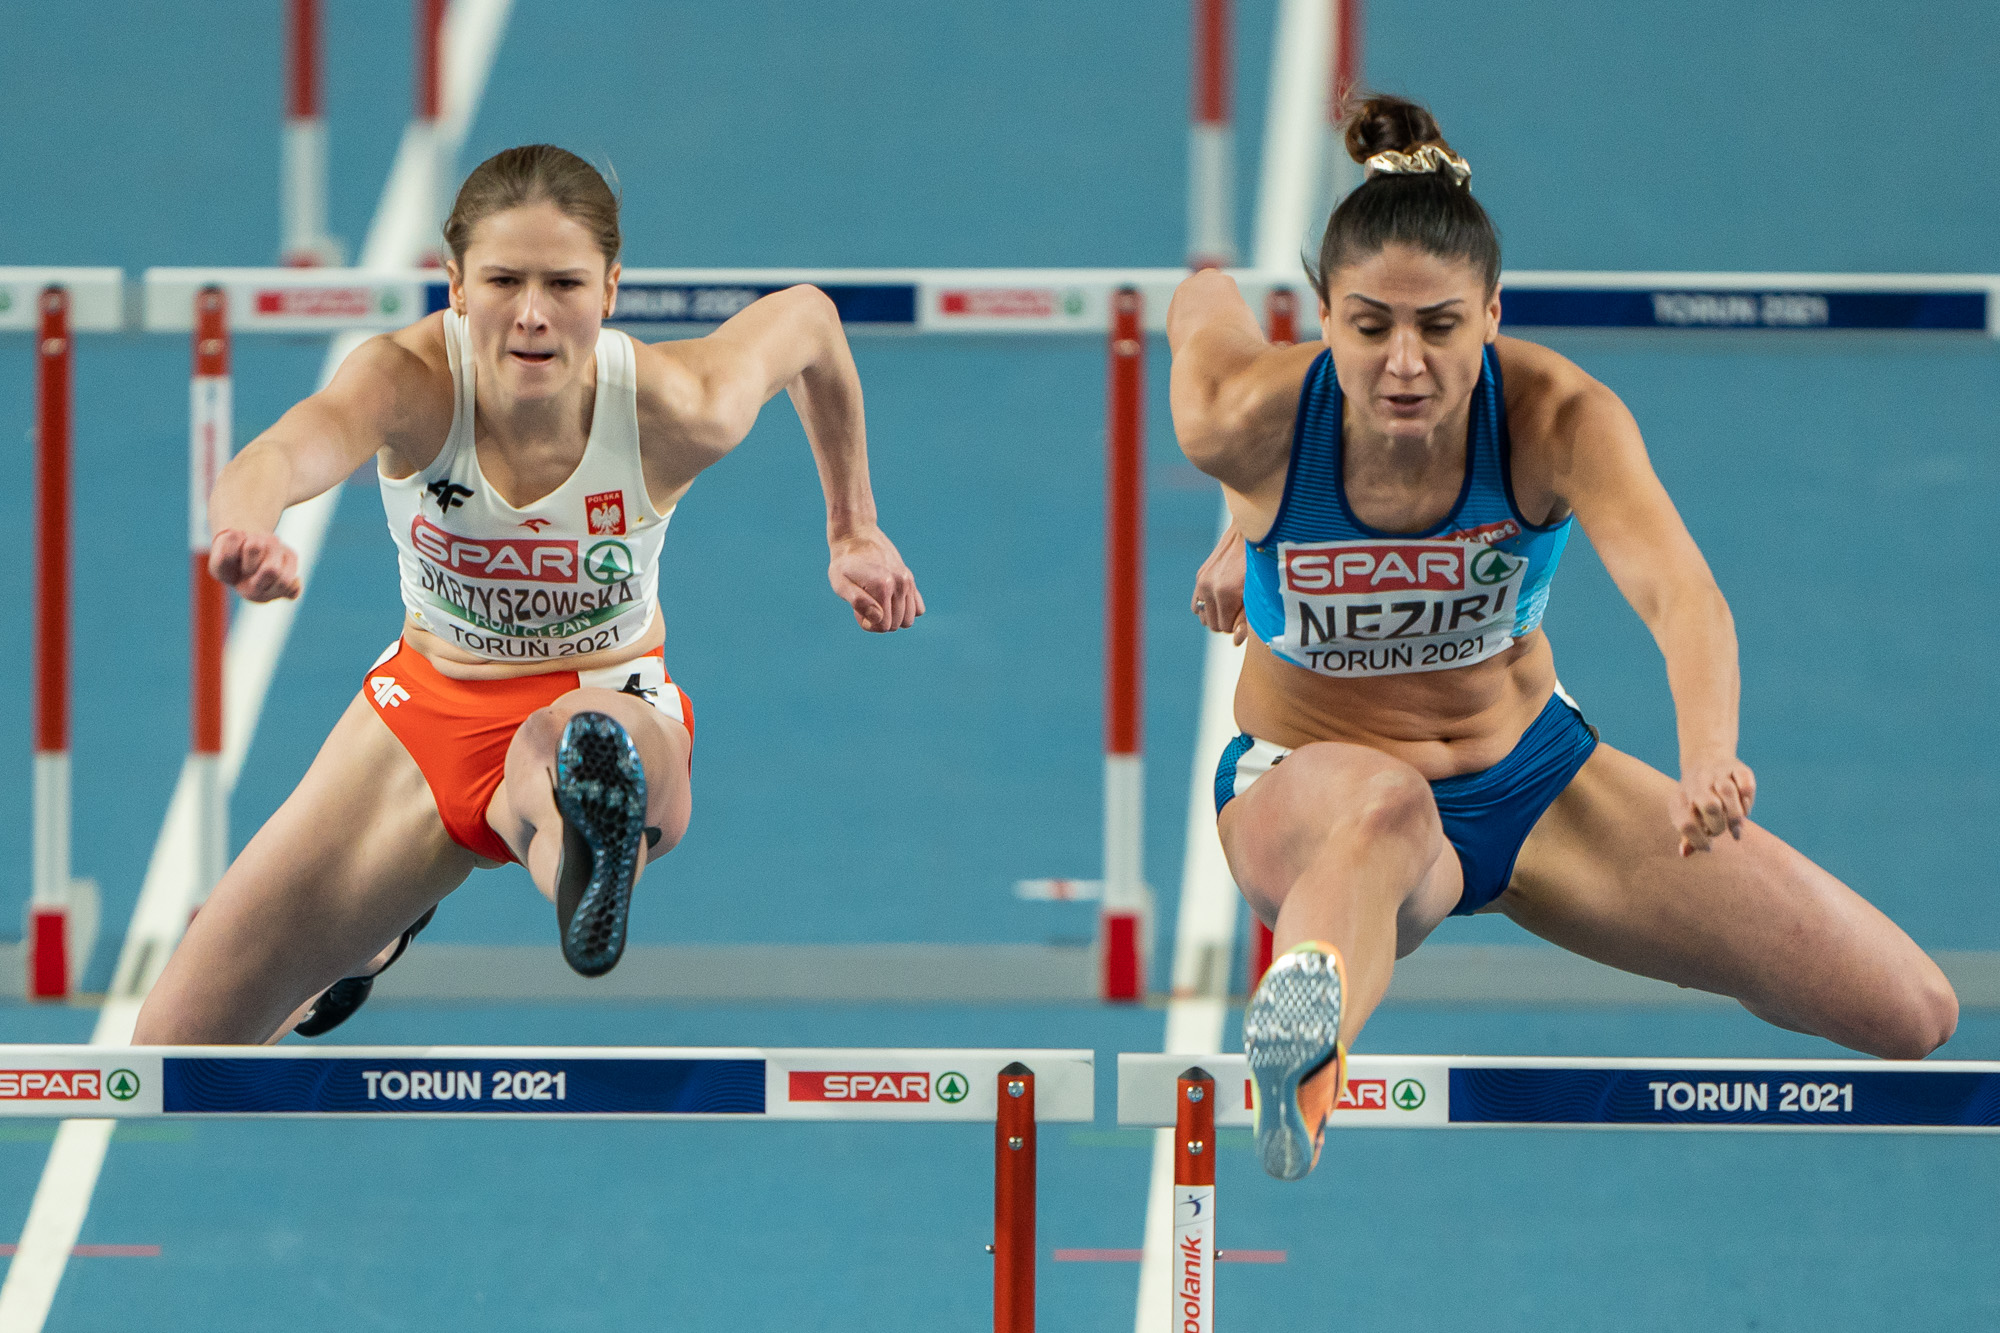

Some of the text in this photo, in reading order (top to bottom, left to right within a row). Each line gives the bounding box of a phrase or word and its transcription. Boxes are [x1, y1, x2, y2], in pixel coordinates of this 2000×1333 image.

[414, 524, 574, 577] SPAR
[1291, 551, 1460, 589] SPAR
[1299, 585, 1509, 647] NEZIRI
[449, 623, 621, 657] TORUŃ 2021
[1306, 635, 1484, 671] TORUŃ 2021
[0, 1073, 99, 1097] SPAR
[363, 1071, 567, 1100] TORUN 2021
[823, 1075, 928, 1100] SPAR
[1649, 1082, 1854, 1113] TORUN 2021
